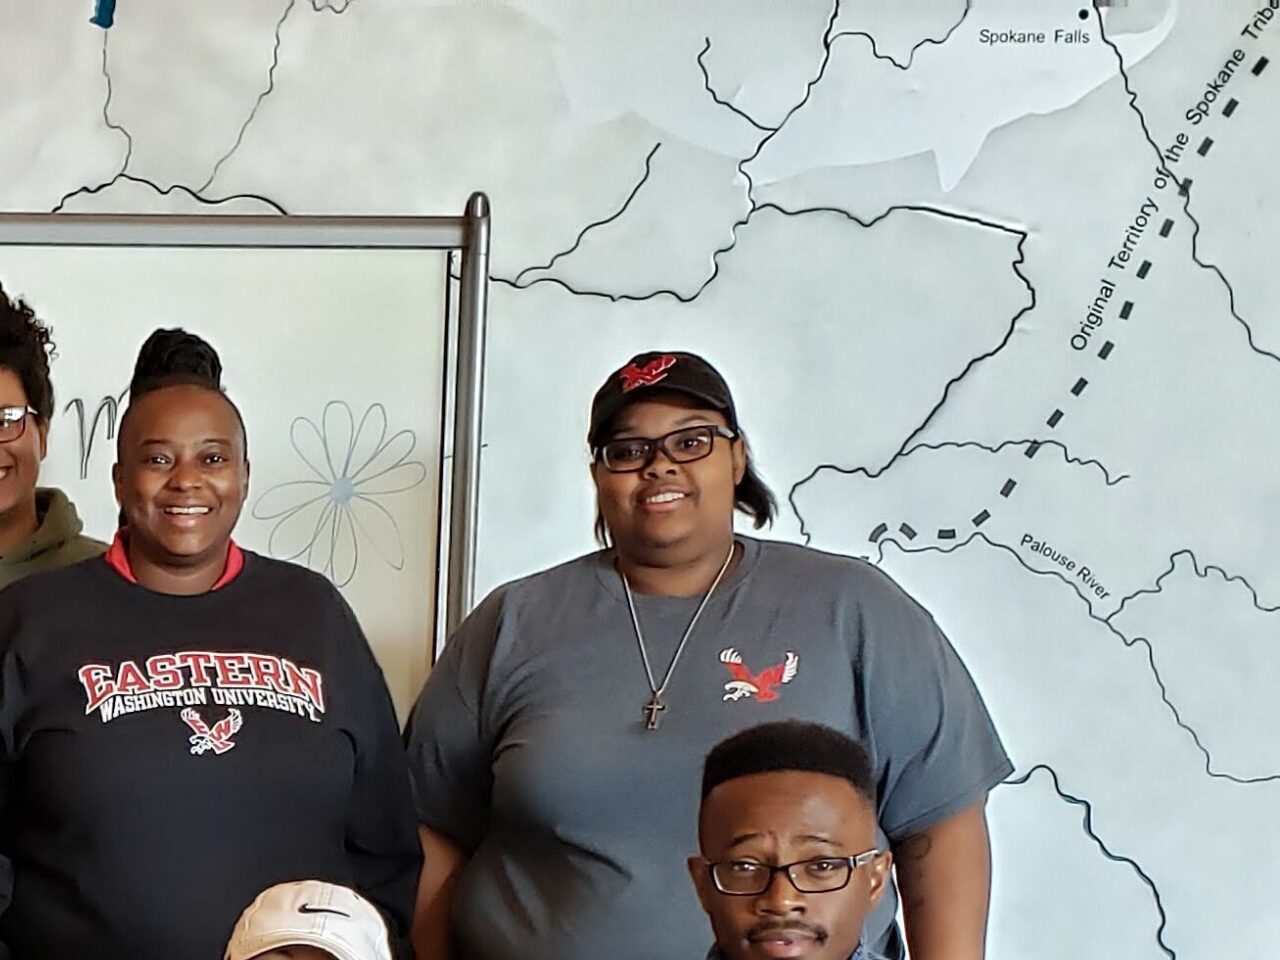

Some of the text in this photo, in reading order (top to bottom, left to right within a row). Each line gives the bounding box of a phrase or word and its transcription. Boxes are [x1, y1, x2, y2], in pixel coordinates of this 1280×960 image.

[978, 28, 1091, 46] Spokane Falls
[1070, 278, 1116, 351] Original
[1107, 197, 1159, 270] Territory
[1154, 166, 1171, 190] of
[1164, 132, 1190, 163] the
[1185, 48, 1246, 125] Spokane
[1020, 533, 1111, 600] Palouse River
[78, 651, 326, 716] EASTERN
[99, 687, 208, 724] WASHINGTON
